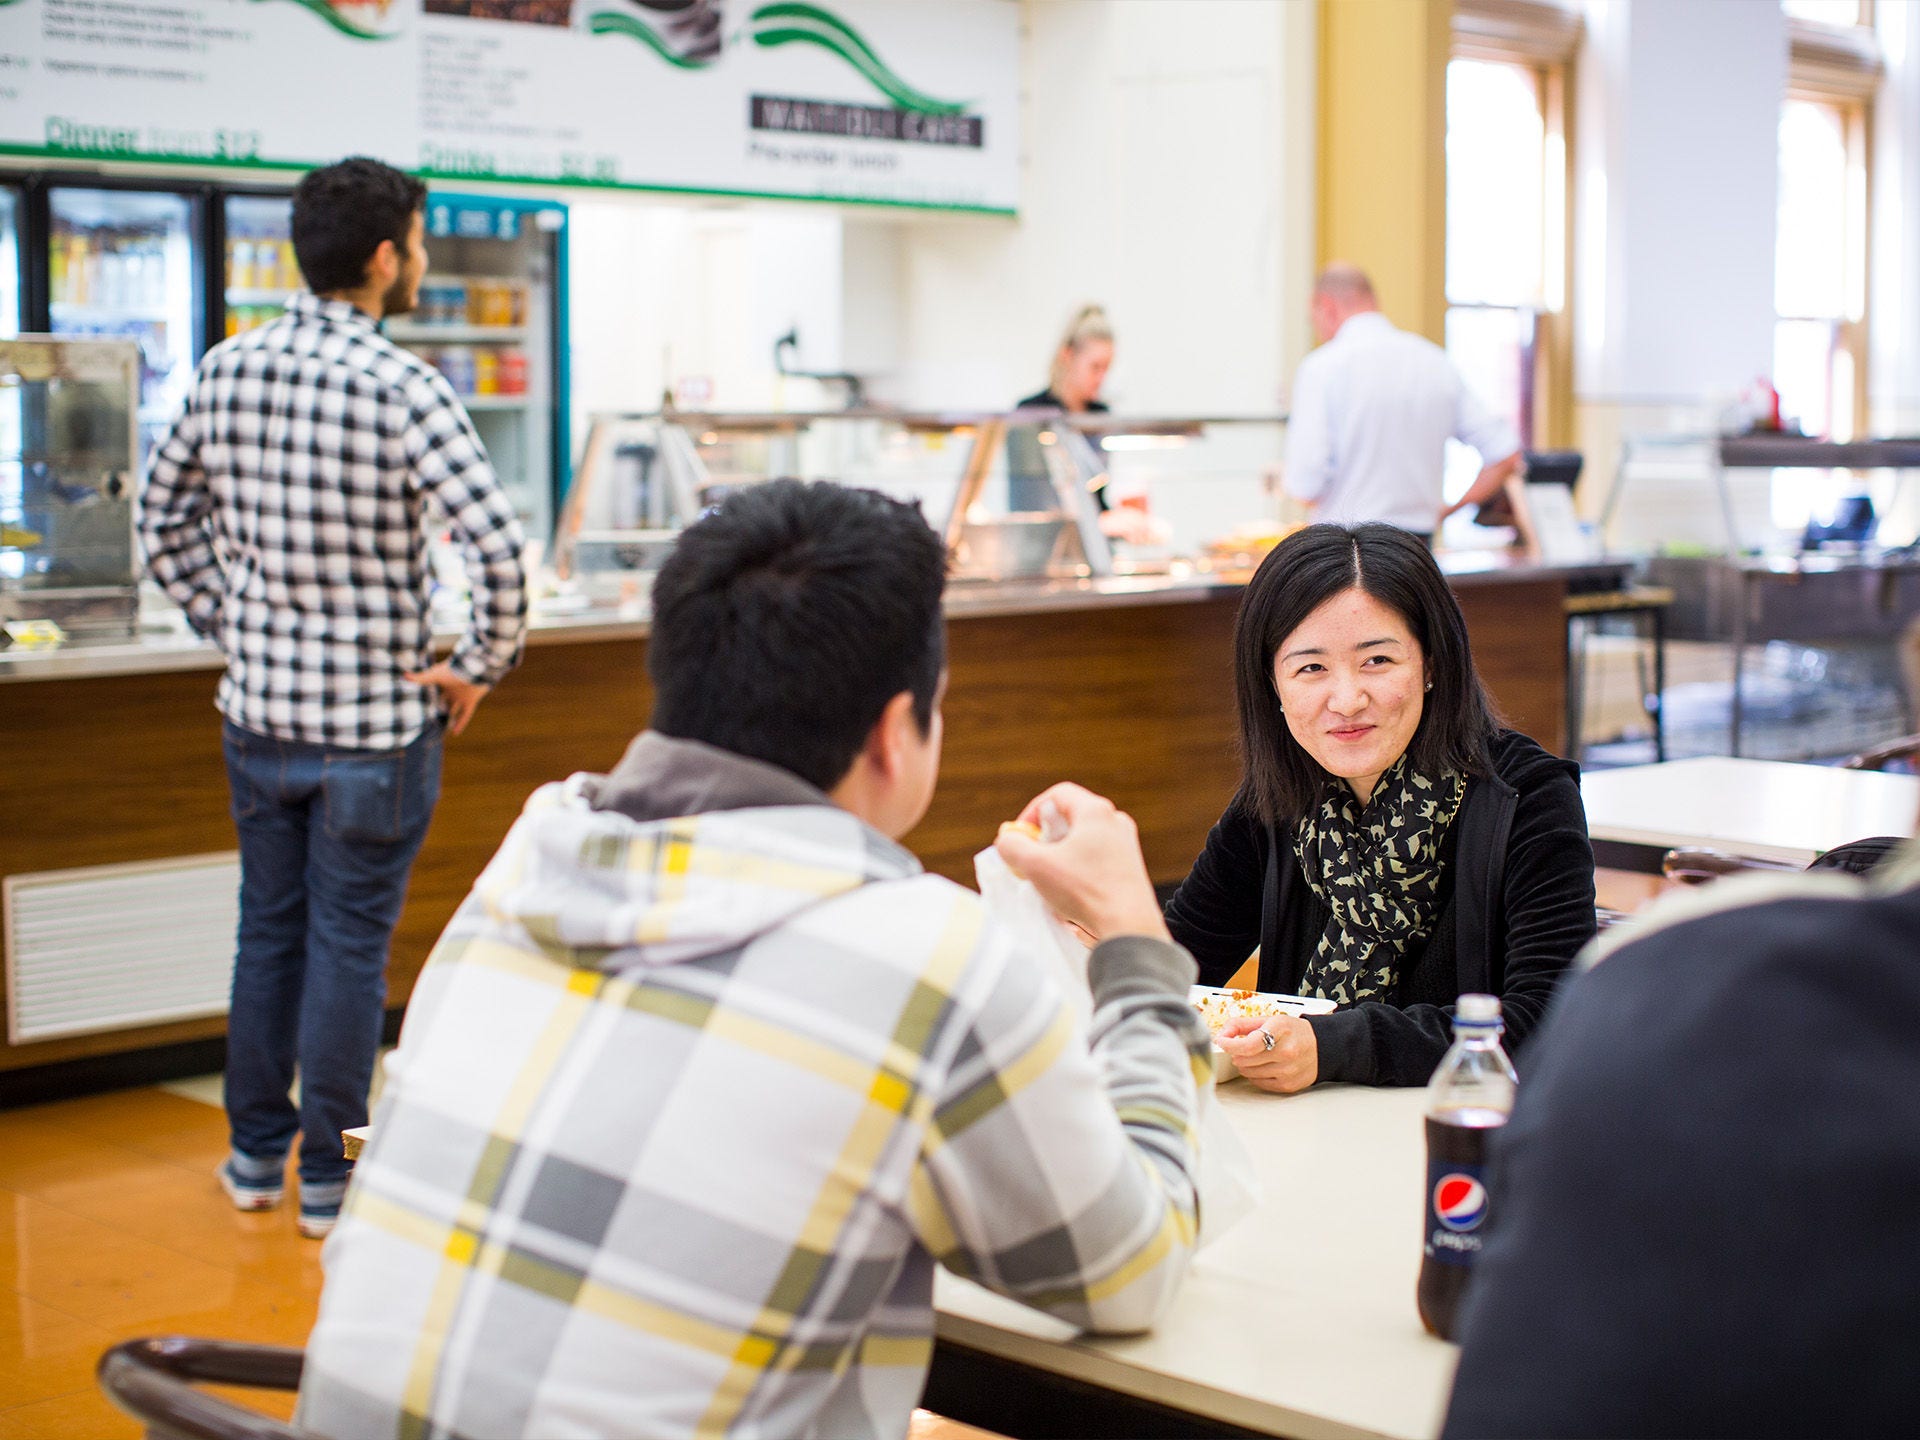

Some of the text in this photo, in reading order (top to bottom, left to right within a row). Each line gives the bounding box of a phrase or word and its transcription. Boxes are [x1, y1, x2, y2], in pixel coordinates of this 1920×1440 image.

[46, 117, 137, 153] Dinner
[903, 112, 974, 146] CAFE
[1432, 1229, 1482, 1252] peps
